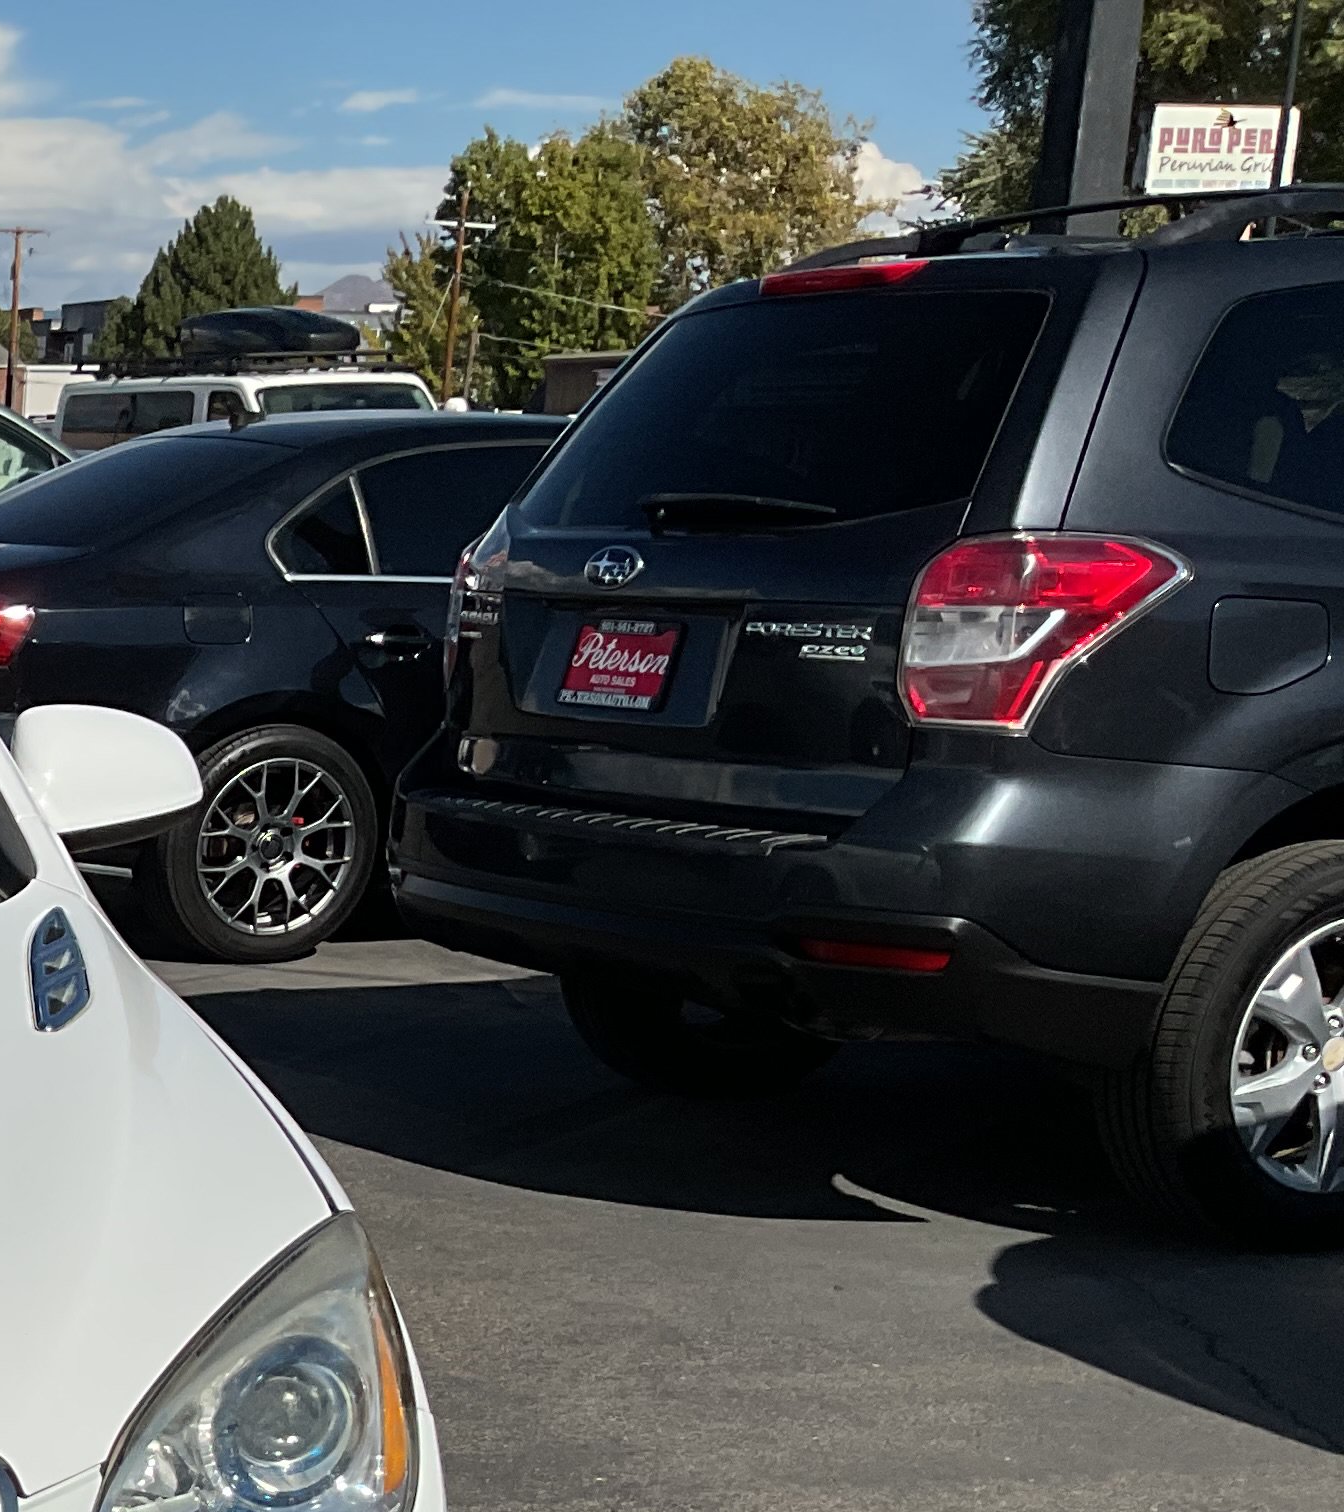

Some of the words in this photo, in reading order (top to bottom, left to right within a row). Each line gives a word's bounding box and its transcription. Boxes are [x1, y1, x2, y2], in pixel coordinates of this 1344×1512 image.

[1158, 127, 1223, 154] PURO
[1226, 127, 1276, 154] PER
[1158, 156, 1236, 173] Peruvian
[1240, 156, 1274, 173] Gril
[746, 621, 872, 641] FORESTER
[572, 632, 670, 675] Peterson
[589, 674, 611, 685] AUTO
[611, 675, 637, 688] SALES
